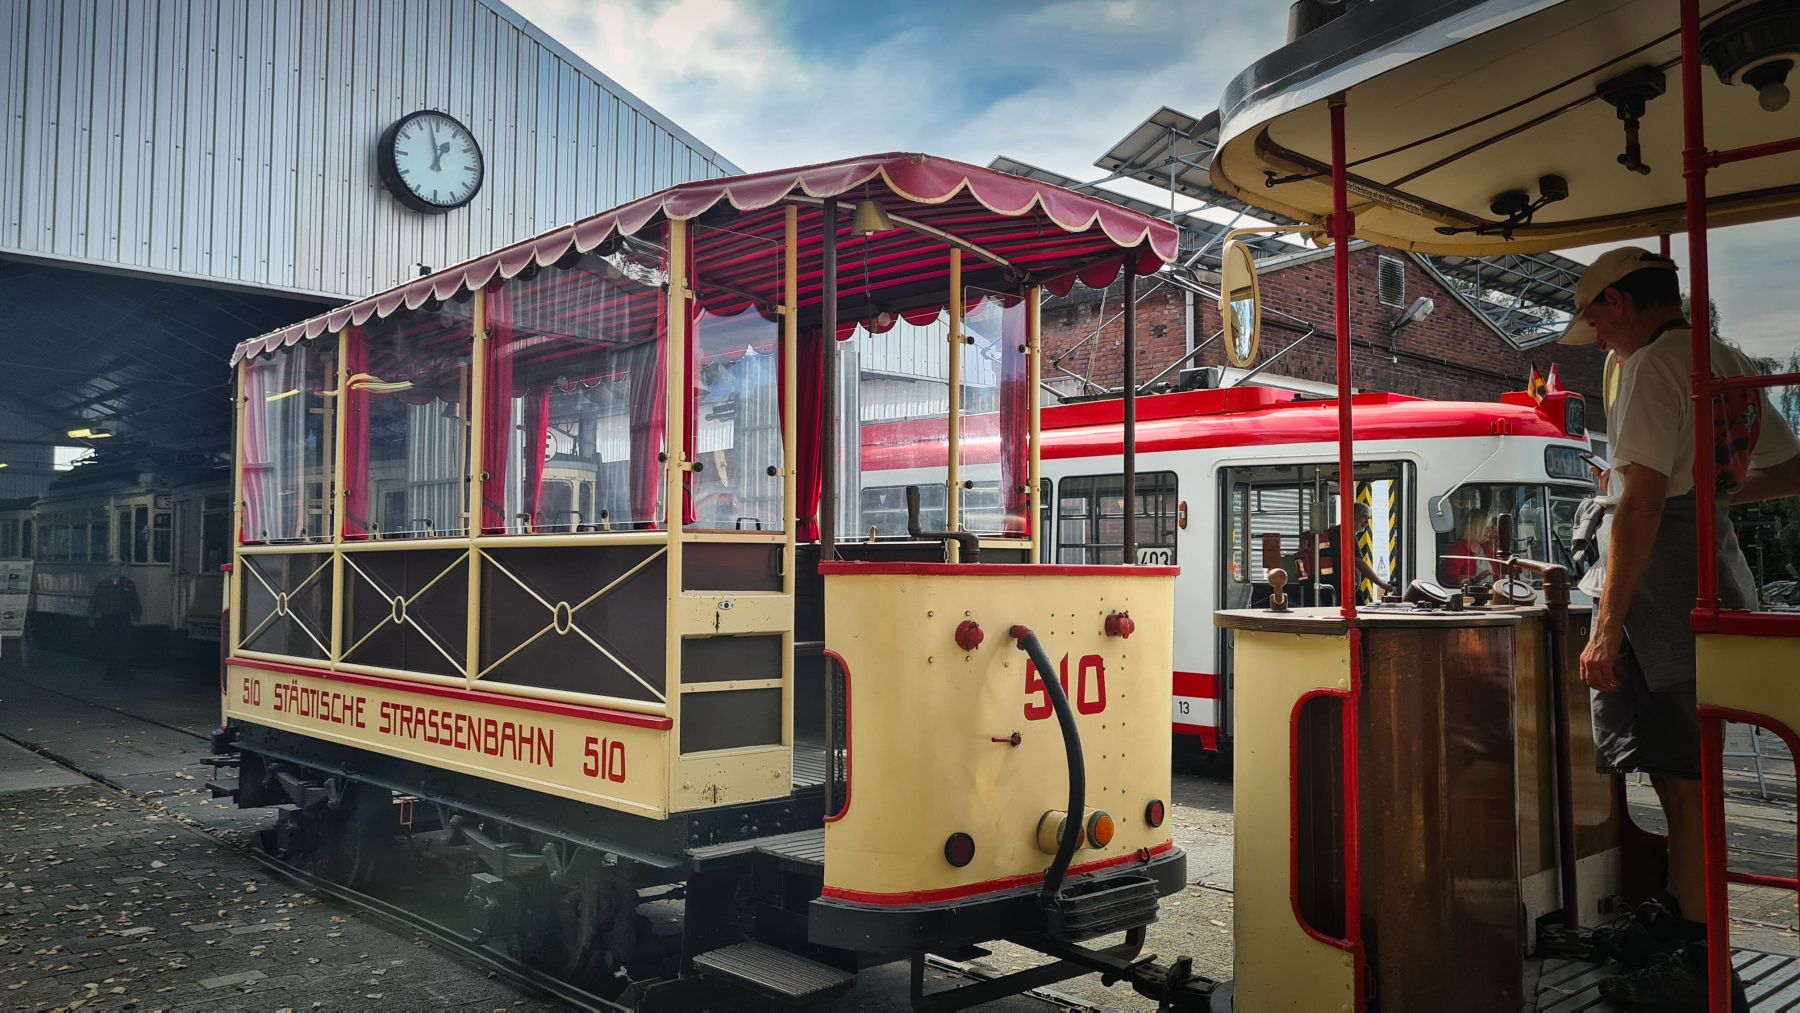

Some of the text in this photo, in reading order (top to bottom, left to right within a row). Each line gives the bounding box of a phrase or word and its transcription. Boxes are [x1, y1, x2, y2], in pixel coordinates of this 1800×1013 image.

[1023, 651, 1107, 721] 510
[1178, 700, 1190, 715] 13
[242, 677, 626, 784] 510 STÄDTISCHE STRASSENBAHN 510
